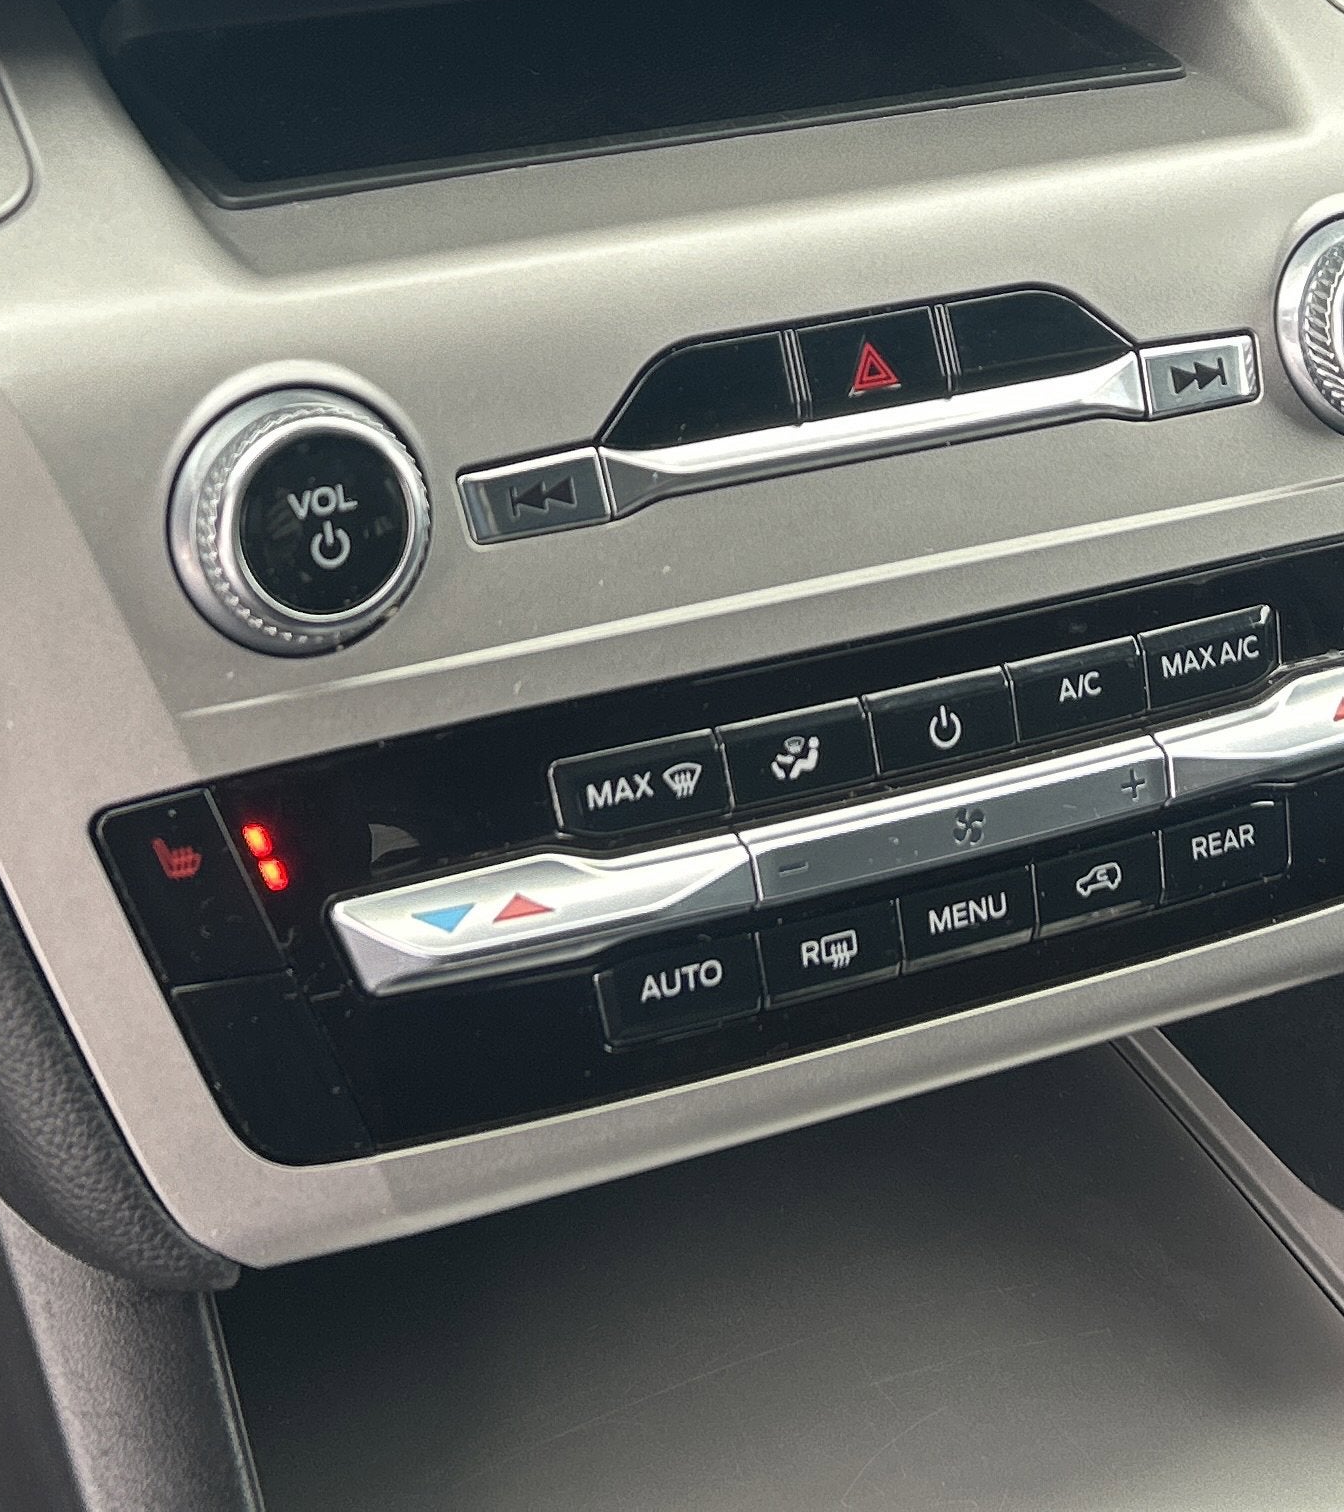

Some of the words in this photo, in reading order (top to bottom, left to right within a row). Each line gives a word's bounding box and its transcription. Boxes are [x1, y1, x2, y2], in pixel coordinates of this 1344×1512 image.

[288, 483, 358, 520] VOL
[1160, 646, 1219, 679] MAX
[1218, 635, 1261, 665] A/C
[1057, 669, 1103, 704] A/C
[585, 770, 656, 812] MAX
[1190, 822, 1257, 861] REAR
[928, 891, 1009, 935] MENU
[639, 958, 724, 1003] AUTO
